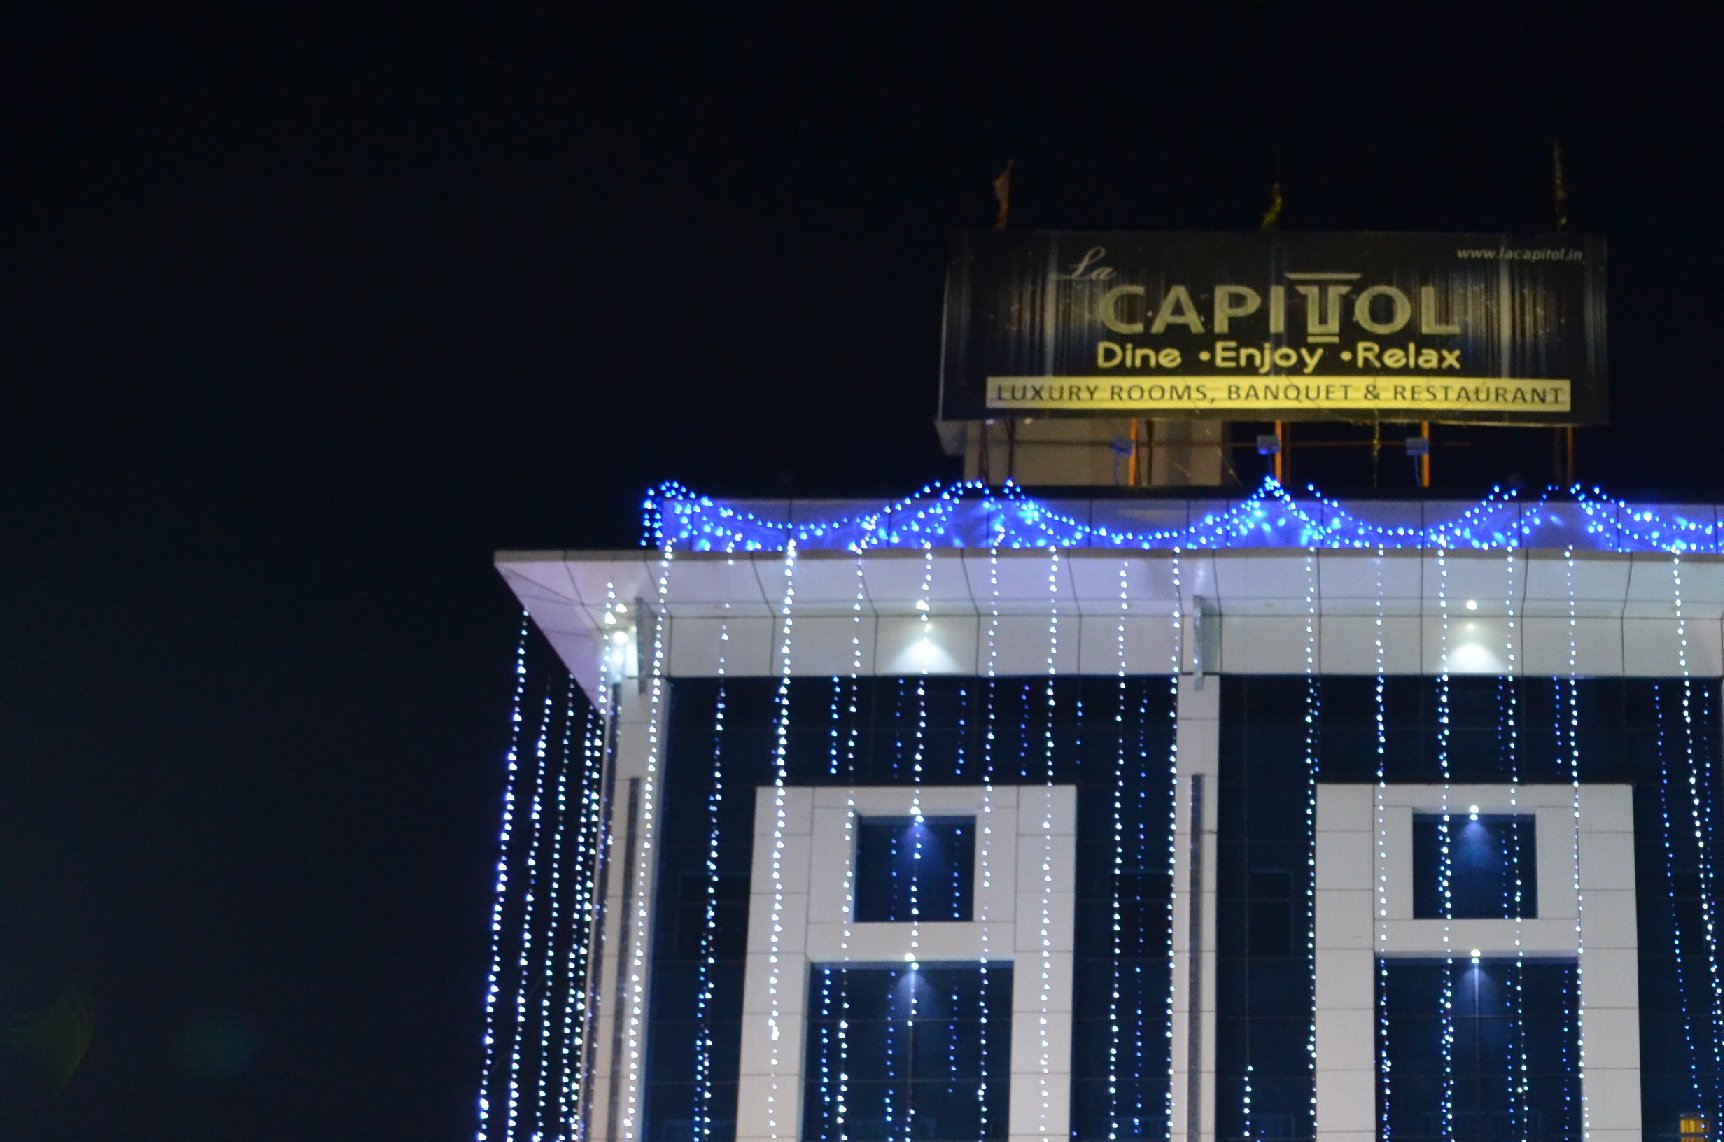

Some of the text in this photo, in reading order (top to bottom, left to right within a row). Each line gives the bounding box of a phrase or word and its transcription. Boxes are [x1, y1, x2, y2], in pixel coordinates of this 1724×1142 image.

[1100, 272, 1461, 344] CAPITOL
[1096, 342, 1182, 369] Dine
[998, 384, 1563, 404] LUXURY ROOMS, BANQUET & RESTAURANT
